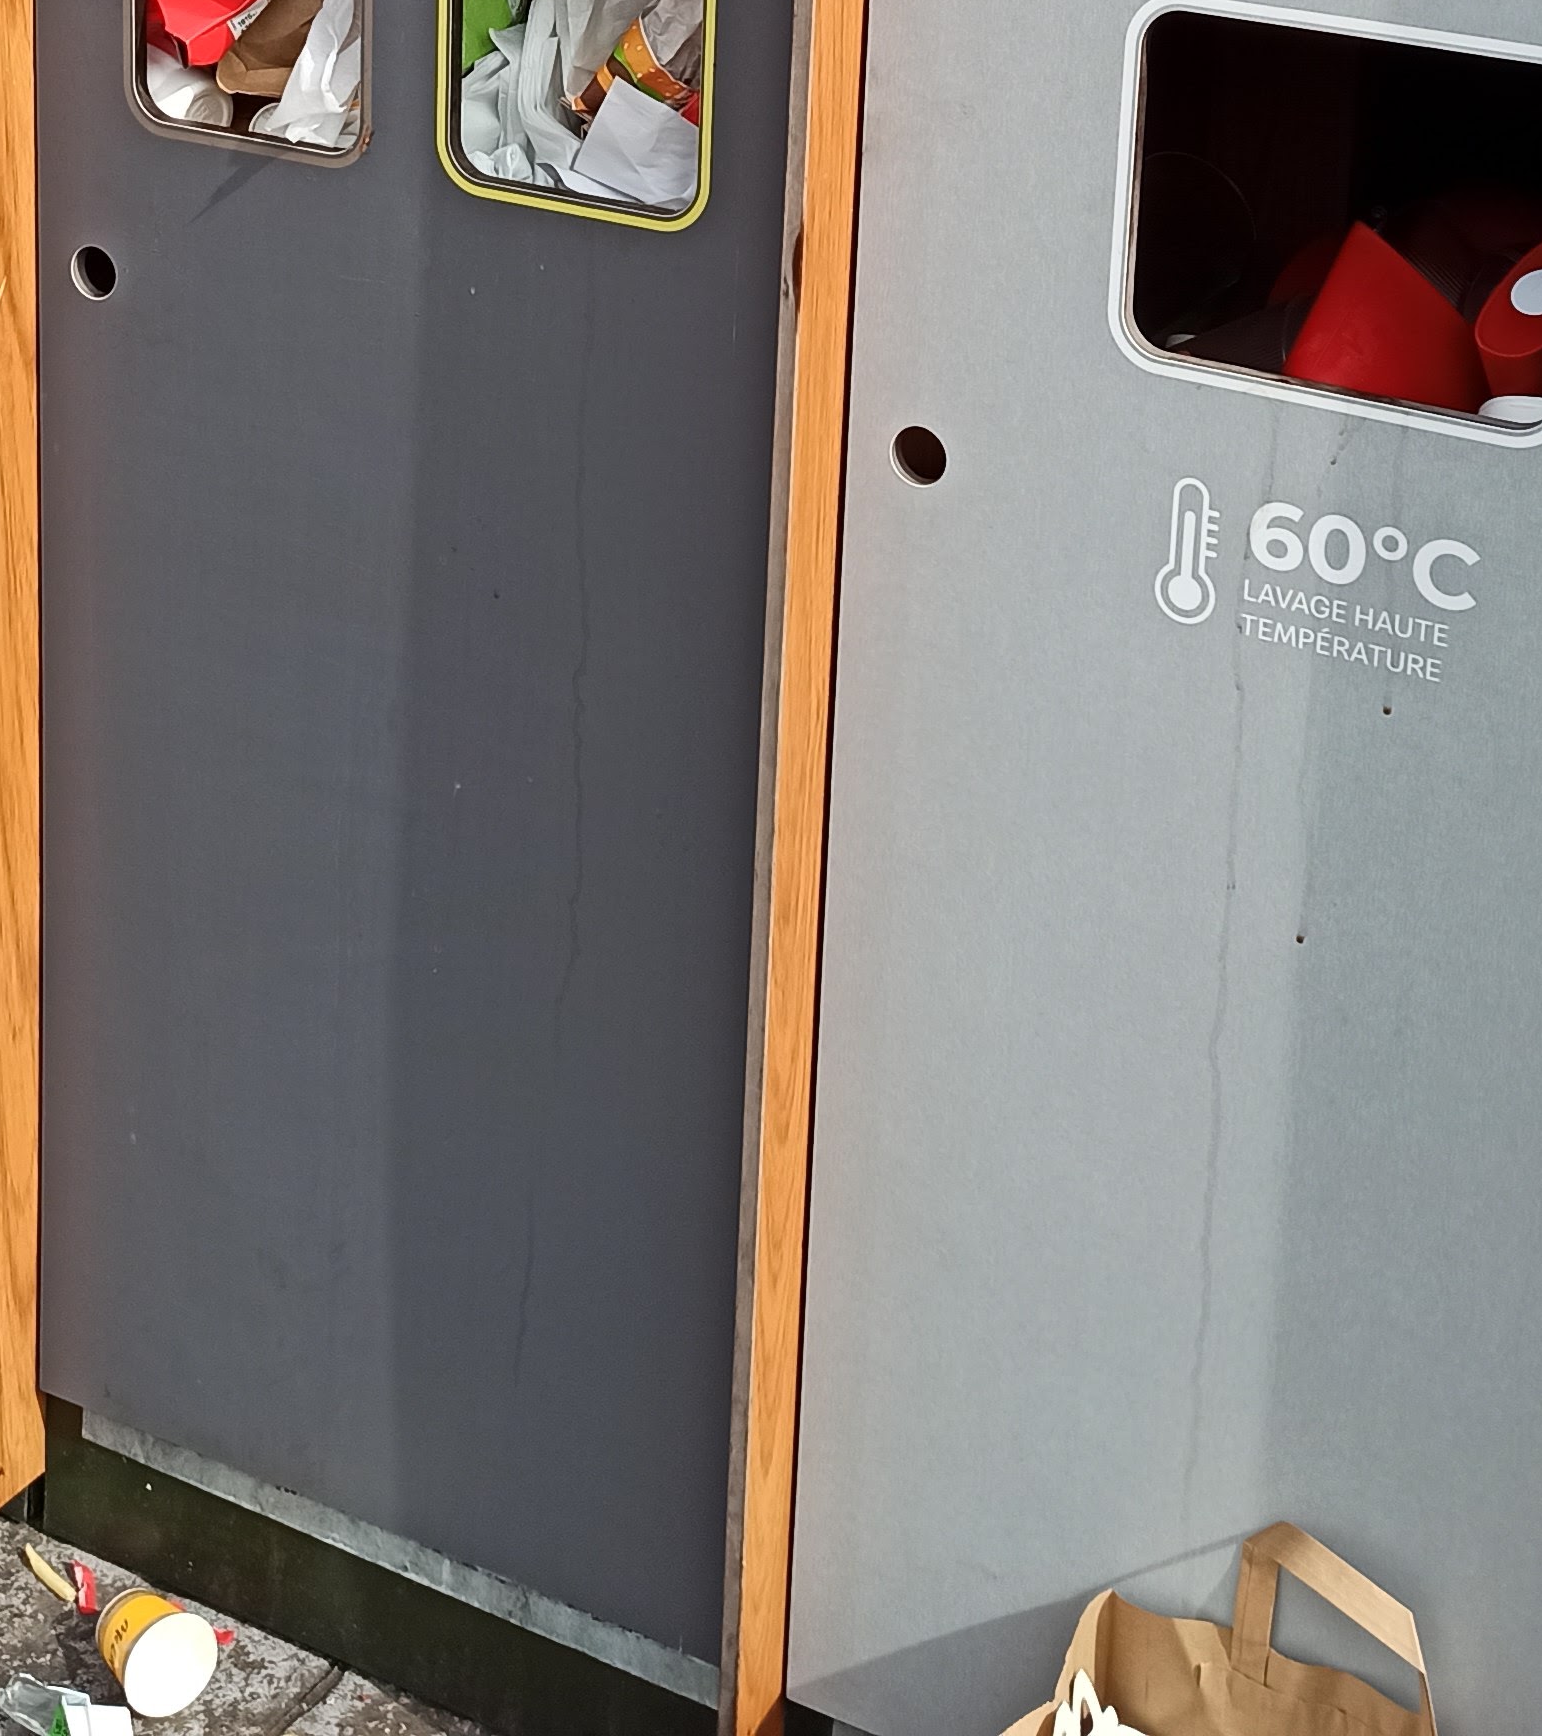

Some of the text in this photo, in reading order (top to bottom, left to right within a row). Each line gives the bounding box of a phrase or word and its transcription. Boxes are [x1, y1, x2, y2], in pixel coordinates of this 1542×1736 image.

[1249, 501, 1481, 611] 60°C
[1241, 612, 1443, 683] TEMPÉRATURE
[1243, 578, 1450, 648] LAVAGE HAUTE
